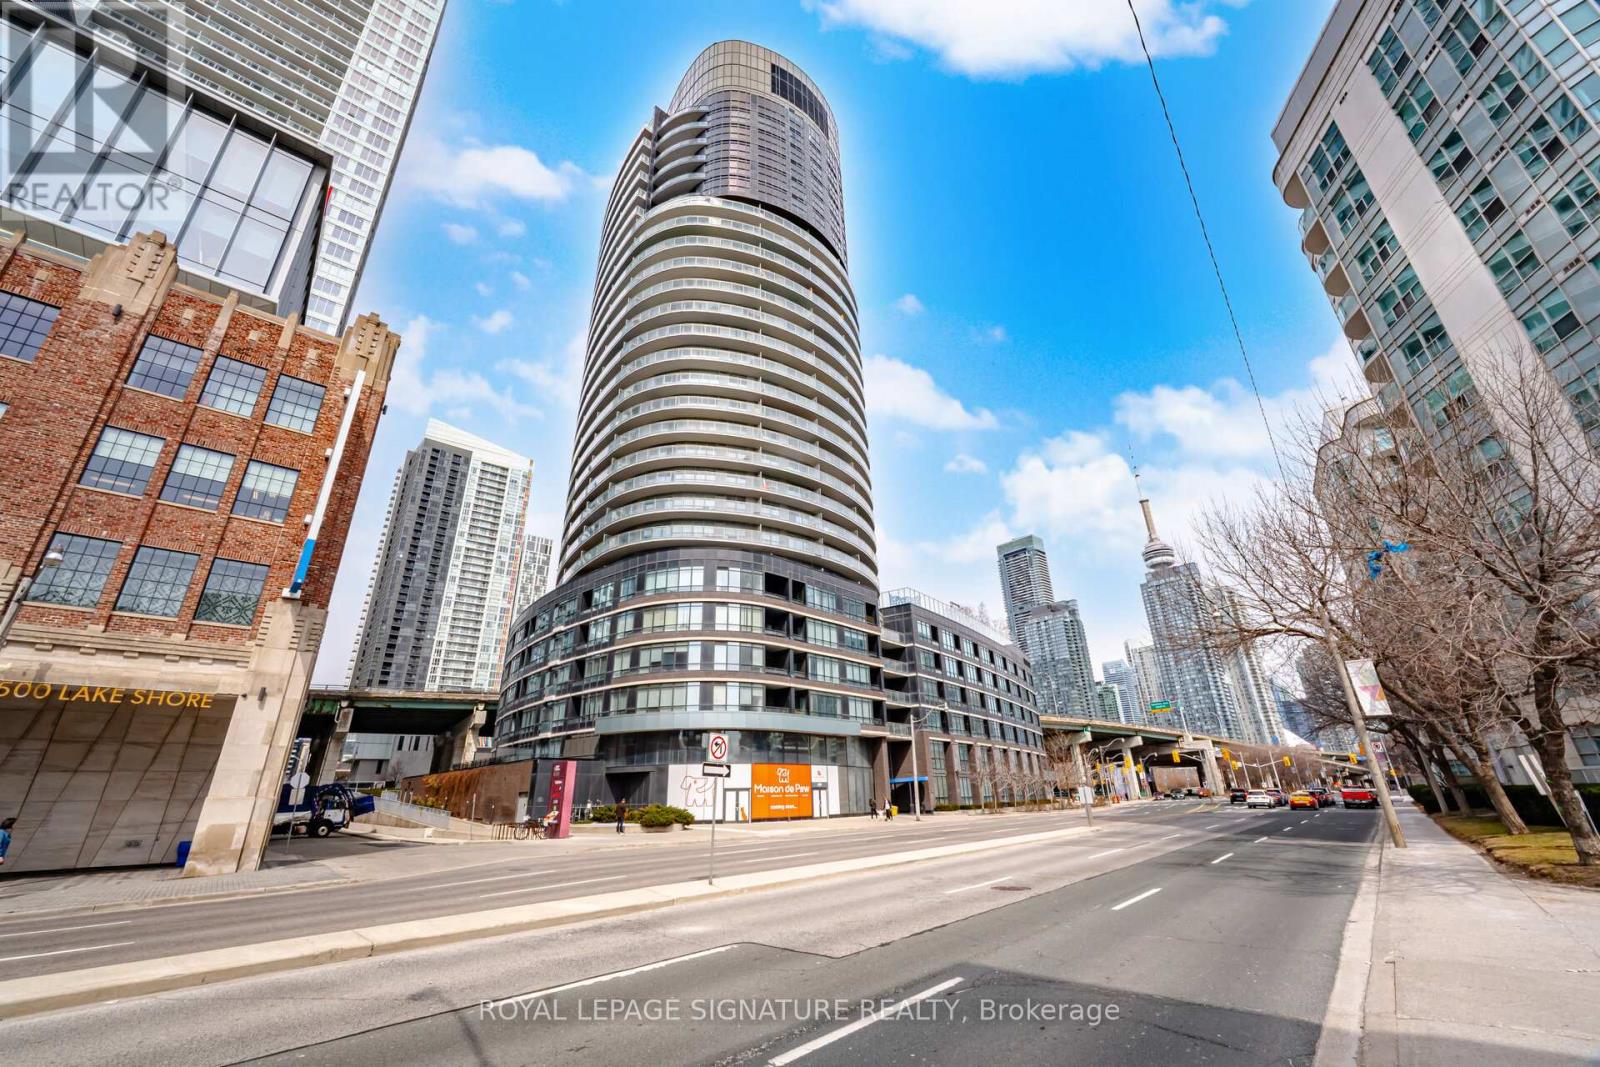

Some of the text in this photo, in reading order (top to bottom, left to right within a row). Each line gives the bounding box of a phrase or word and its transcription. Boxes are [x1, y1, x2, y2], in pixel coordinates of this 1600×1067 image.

[0, 681, 214, 708] 500 LAKE SHORE
[754, 784, 784, 793] Maison
[785, 785, 795, 793] de
